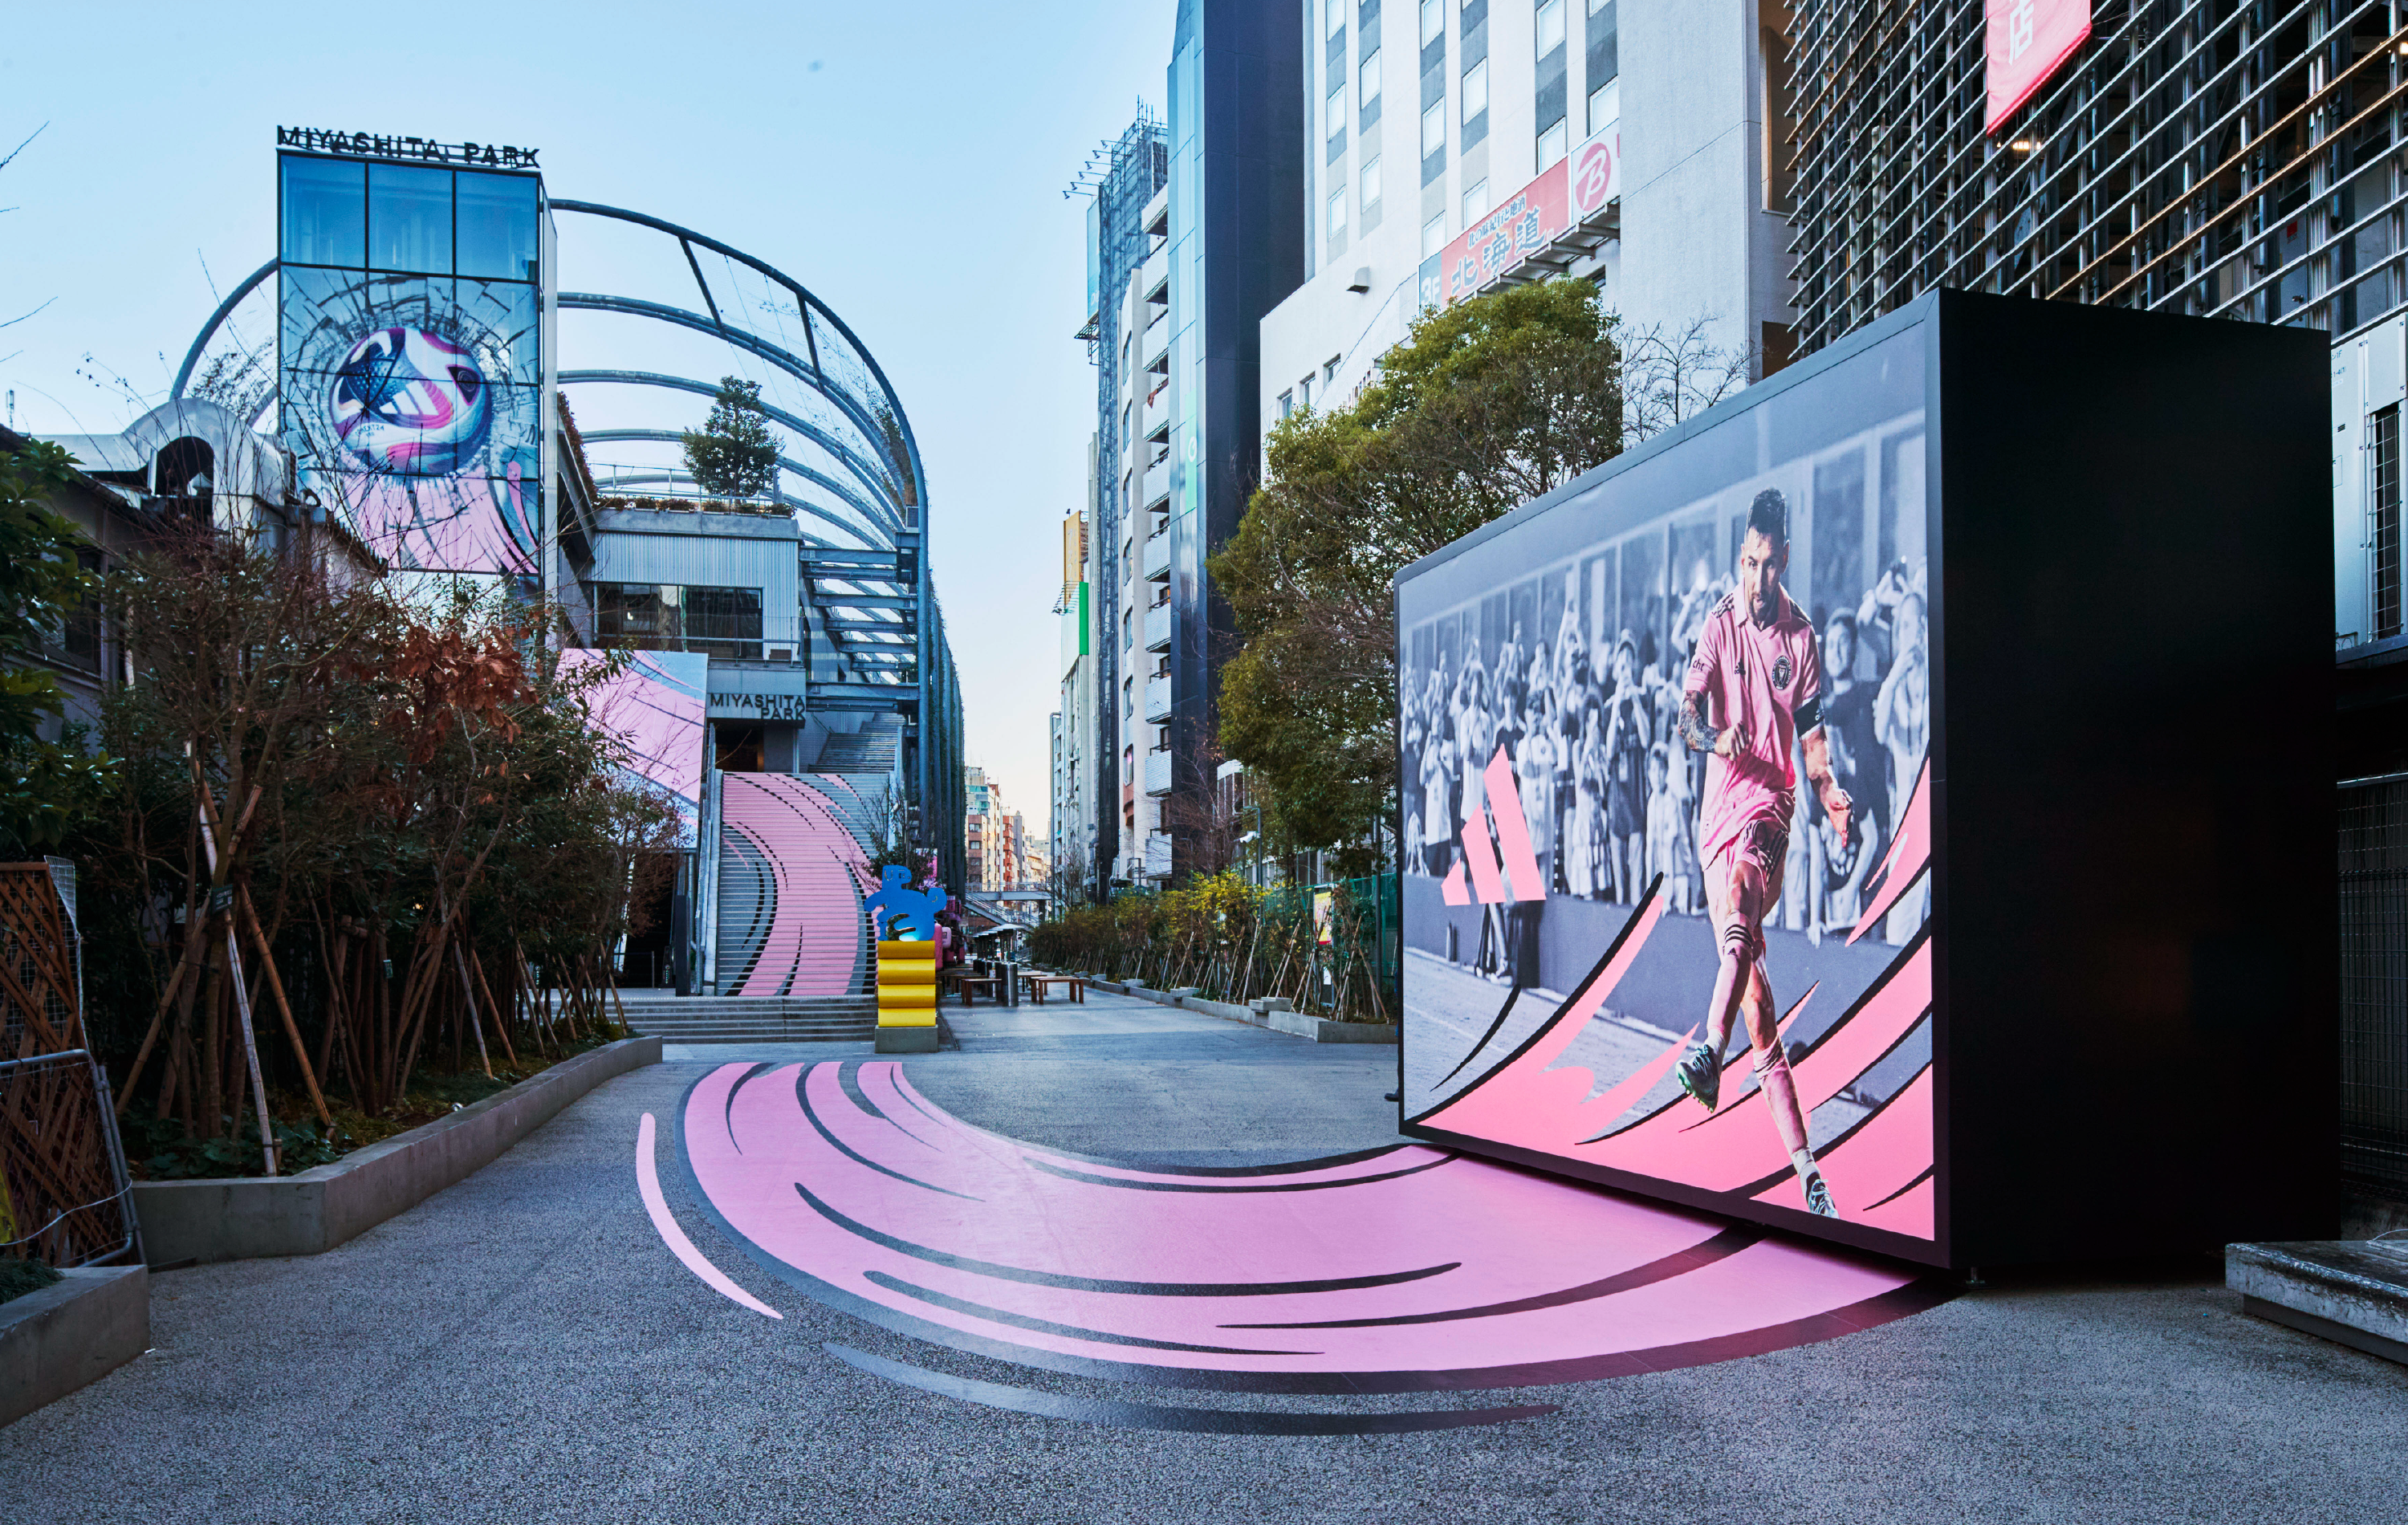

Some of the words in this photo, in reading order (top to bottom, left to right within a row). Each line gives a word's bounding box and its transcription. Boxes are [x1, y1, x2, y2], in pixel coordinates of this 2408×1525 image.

[277, 124, 445, 161] MIYASHITA
[463, 141, 541, 169] PARK
[1450, 205, 1547, 296] 北海道
[1421, 275, 1440, 305] 3F
[710, 693, 805, 709] MIYASHITA
[760, 707, 806, 721] PARK
